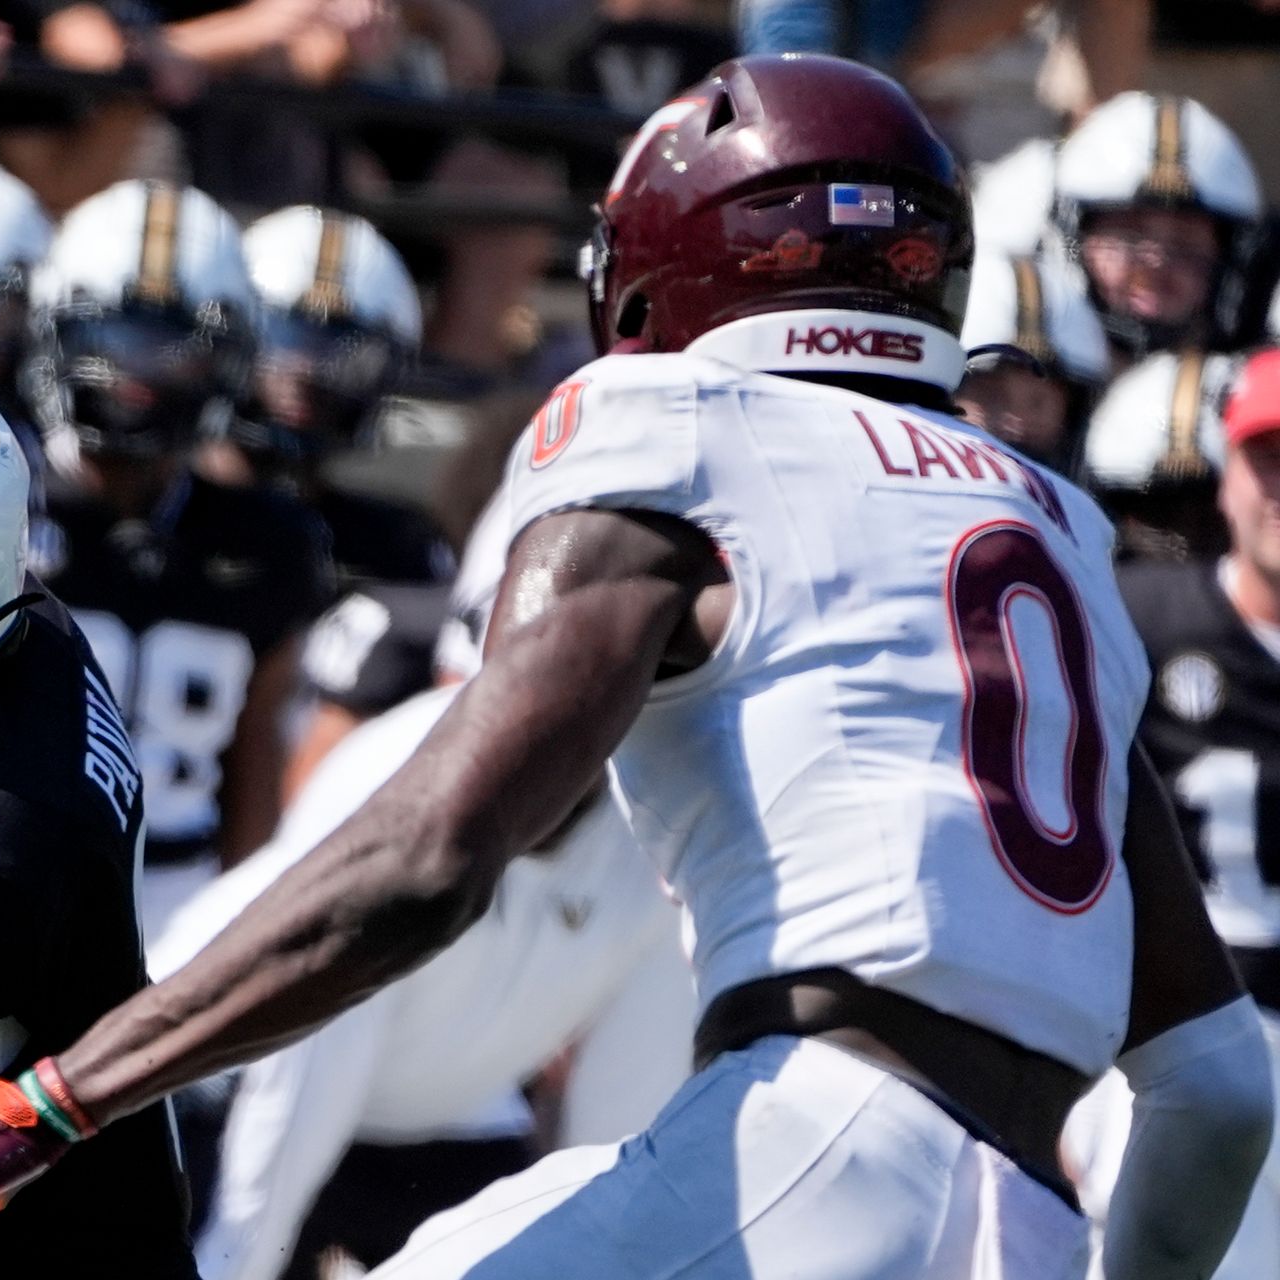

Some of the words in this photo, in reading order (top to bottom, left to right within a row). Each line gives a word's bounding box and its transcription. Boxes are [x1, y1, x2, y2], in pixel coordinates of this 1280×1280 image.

[529, 378, 588, 471] 0
[784, 326, 926, 363] HOKIES
[74, 616, 256, 838] 8
[944, 518, 1116, 917] 0
[1174, 747, 1280, 948] 1
